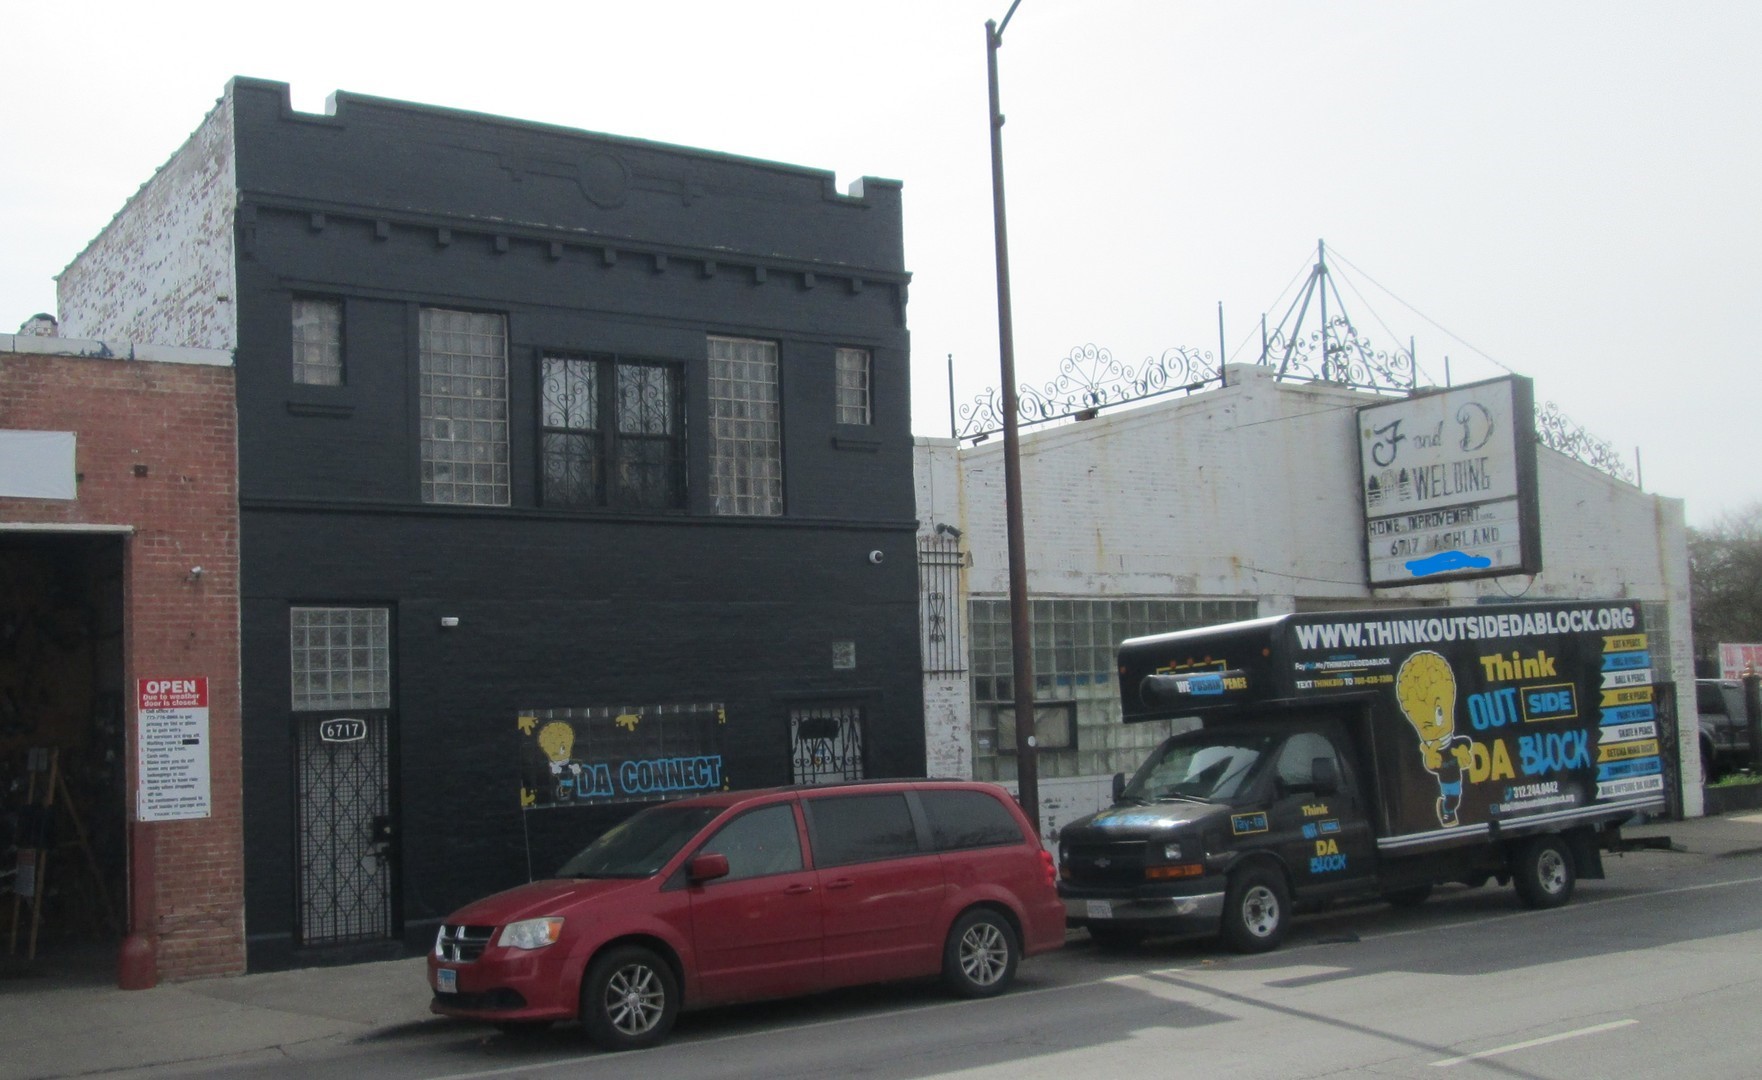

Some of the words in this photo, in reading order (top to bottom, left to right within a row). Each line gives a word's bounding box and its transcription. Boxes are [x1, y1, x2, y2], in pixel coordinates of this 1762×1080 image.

[1413, 421, 1443, 447] and
[1457, 402, 1494, 452] D
[1413, 457, 1491, 501] WELDING
[1370, 520, 1400, 536] HOME
[1409, 507, 1480, 530] IMPROVEMENT
[1391, 538, 1419, 556] 6717
[1433, 527, 1500, 549] ASHLAND
[1295, 608, 1635, 649] WWW.THINKOUTSIDEDABLOCK.ORG
[1480, 650, 1556, 682] Think
[1632, 673, 1645, 682] PEACE
[146, 680, 196, 694] OPEN
[1176, 680, 1191, 693] WE
[1191, 679, 1220, 692] PUSHIN
[1223, 677, 1247, 690] PEACE
[1297, 680, 1312, 689] TEXT
[1467, 688, 1517, 730] OUT
[1528, 691, 1571, 714] SIDE
[328, 724, 358, 737] 6717
[1639, 726, 1653, 735] PEACE
[1470, 739, 1515, 784] DA
[1519, 729, 1590, 776] BLOCK
[577, 764, 614, 797] DA
[620, 755, 721, 794] CONNECT
[1302, 804, 1328, 816] Think
[1316, 839, 1339, 856] DA
